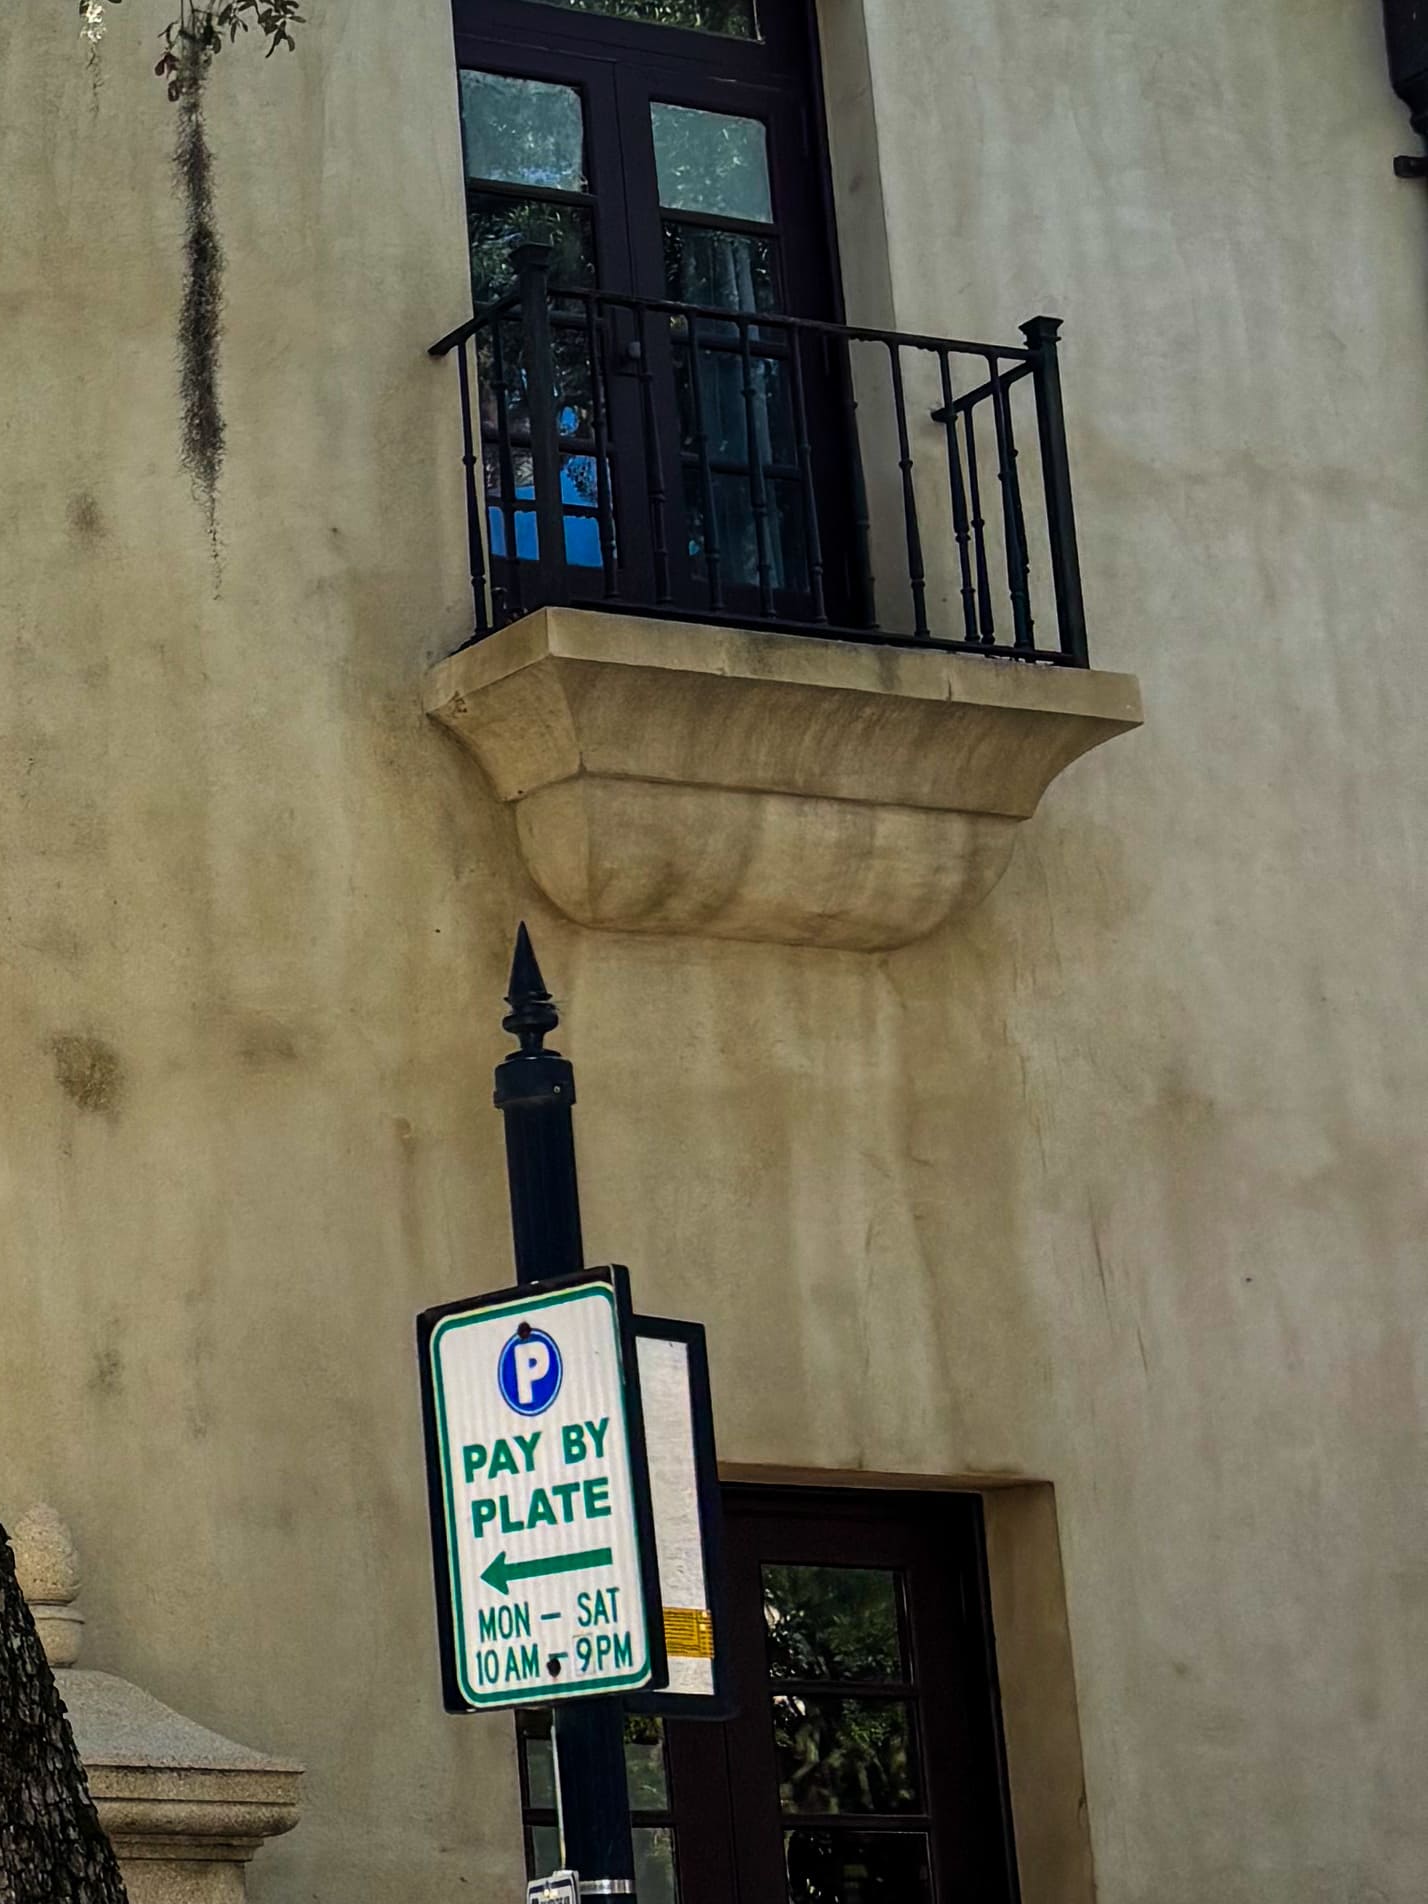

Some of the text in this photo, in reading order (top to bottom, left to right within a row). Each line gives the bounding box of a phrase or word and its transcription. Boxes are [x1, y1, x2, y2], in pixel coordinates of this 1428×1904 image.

[514, 1340, 550, 1404] P
[463, 1417, 609, 1484] PAY BY
[471, 1477, 612, 1538] PLATE
[478, 1601, 531, 1643] MON
[577, 1587, 619, 1627] SAT
